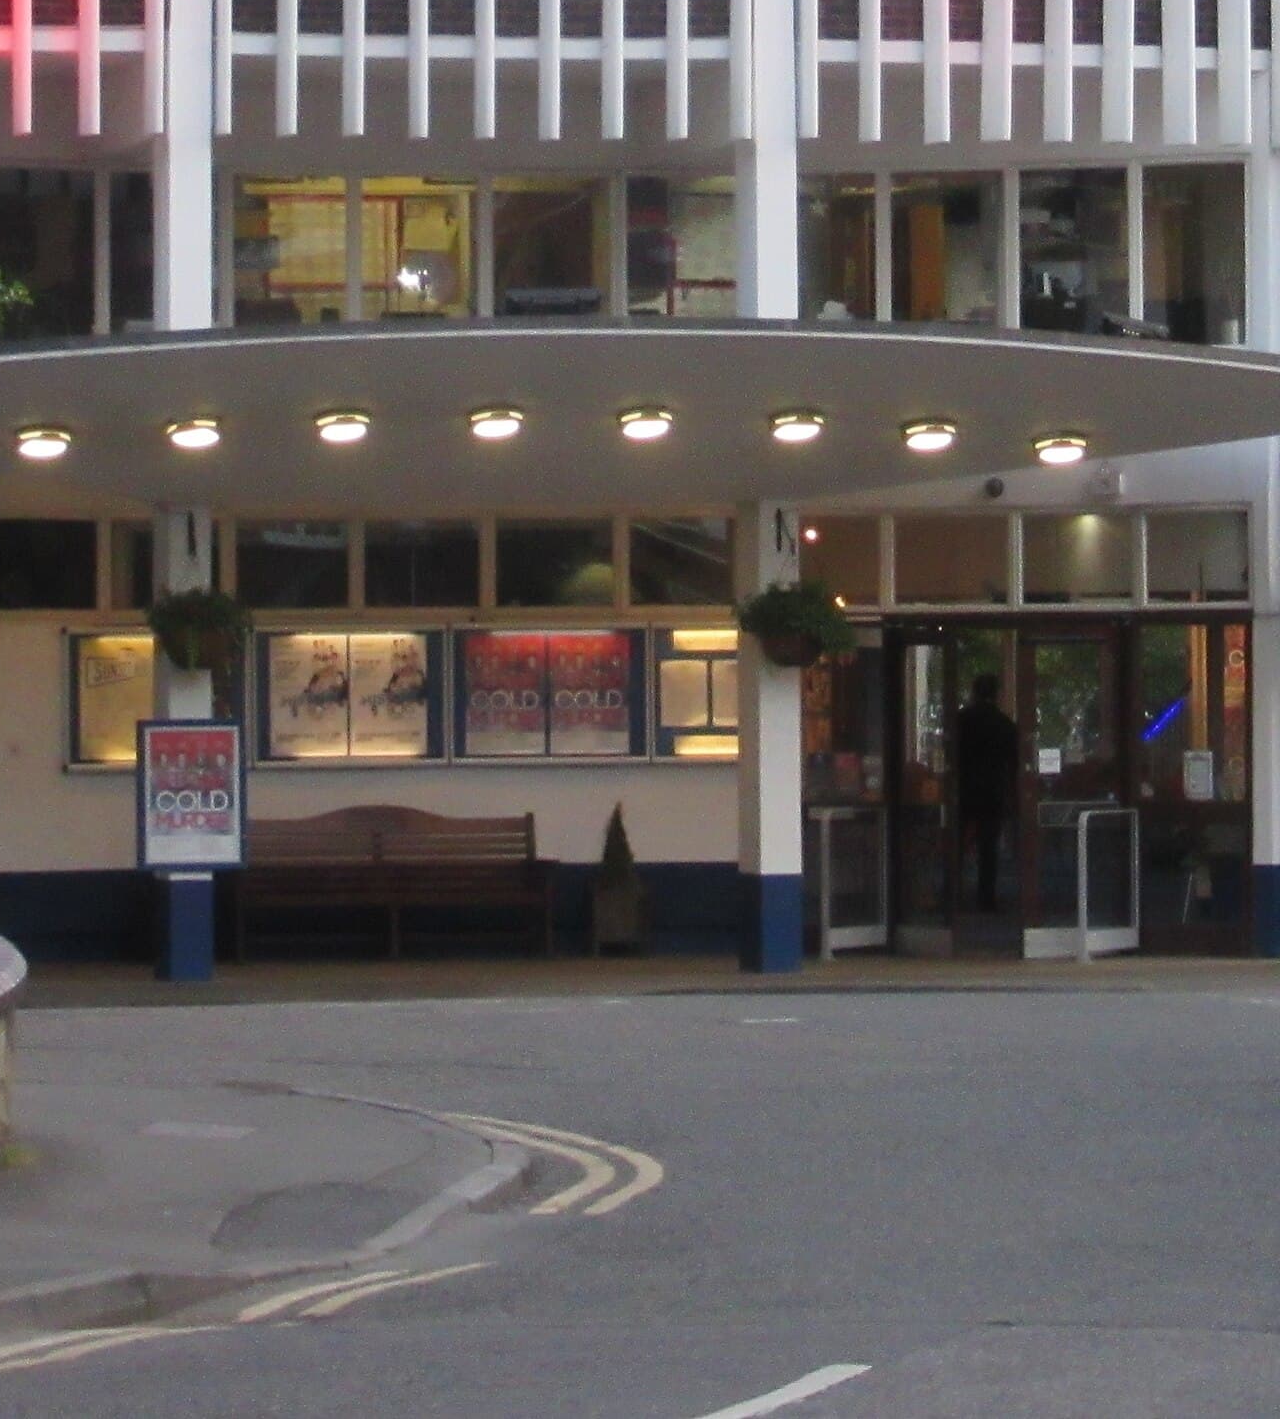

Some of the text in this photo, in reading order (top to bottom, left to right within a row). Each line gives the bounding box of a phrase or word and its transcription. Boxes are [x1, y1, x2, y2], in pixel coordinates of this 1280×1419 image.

[470, 689, 539, 709] COLD
[554, 689, 624, 709] COLD
[156, 789, 229, 812] COLD
